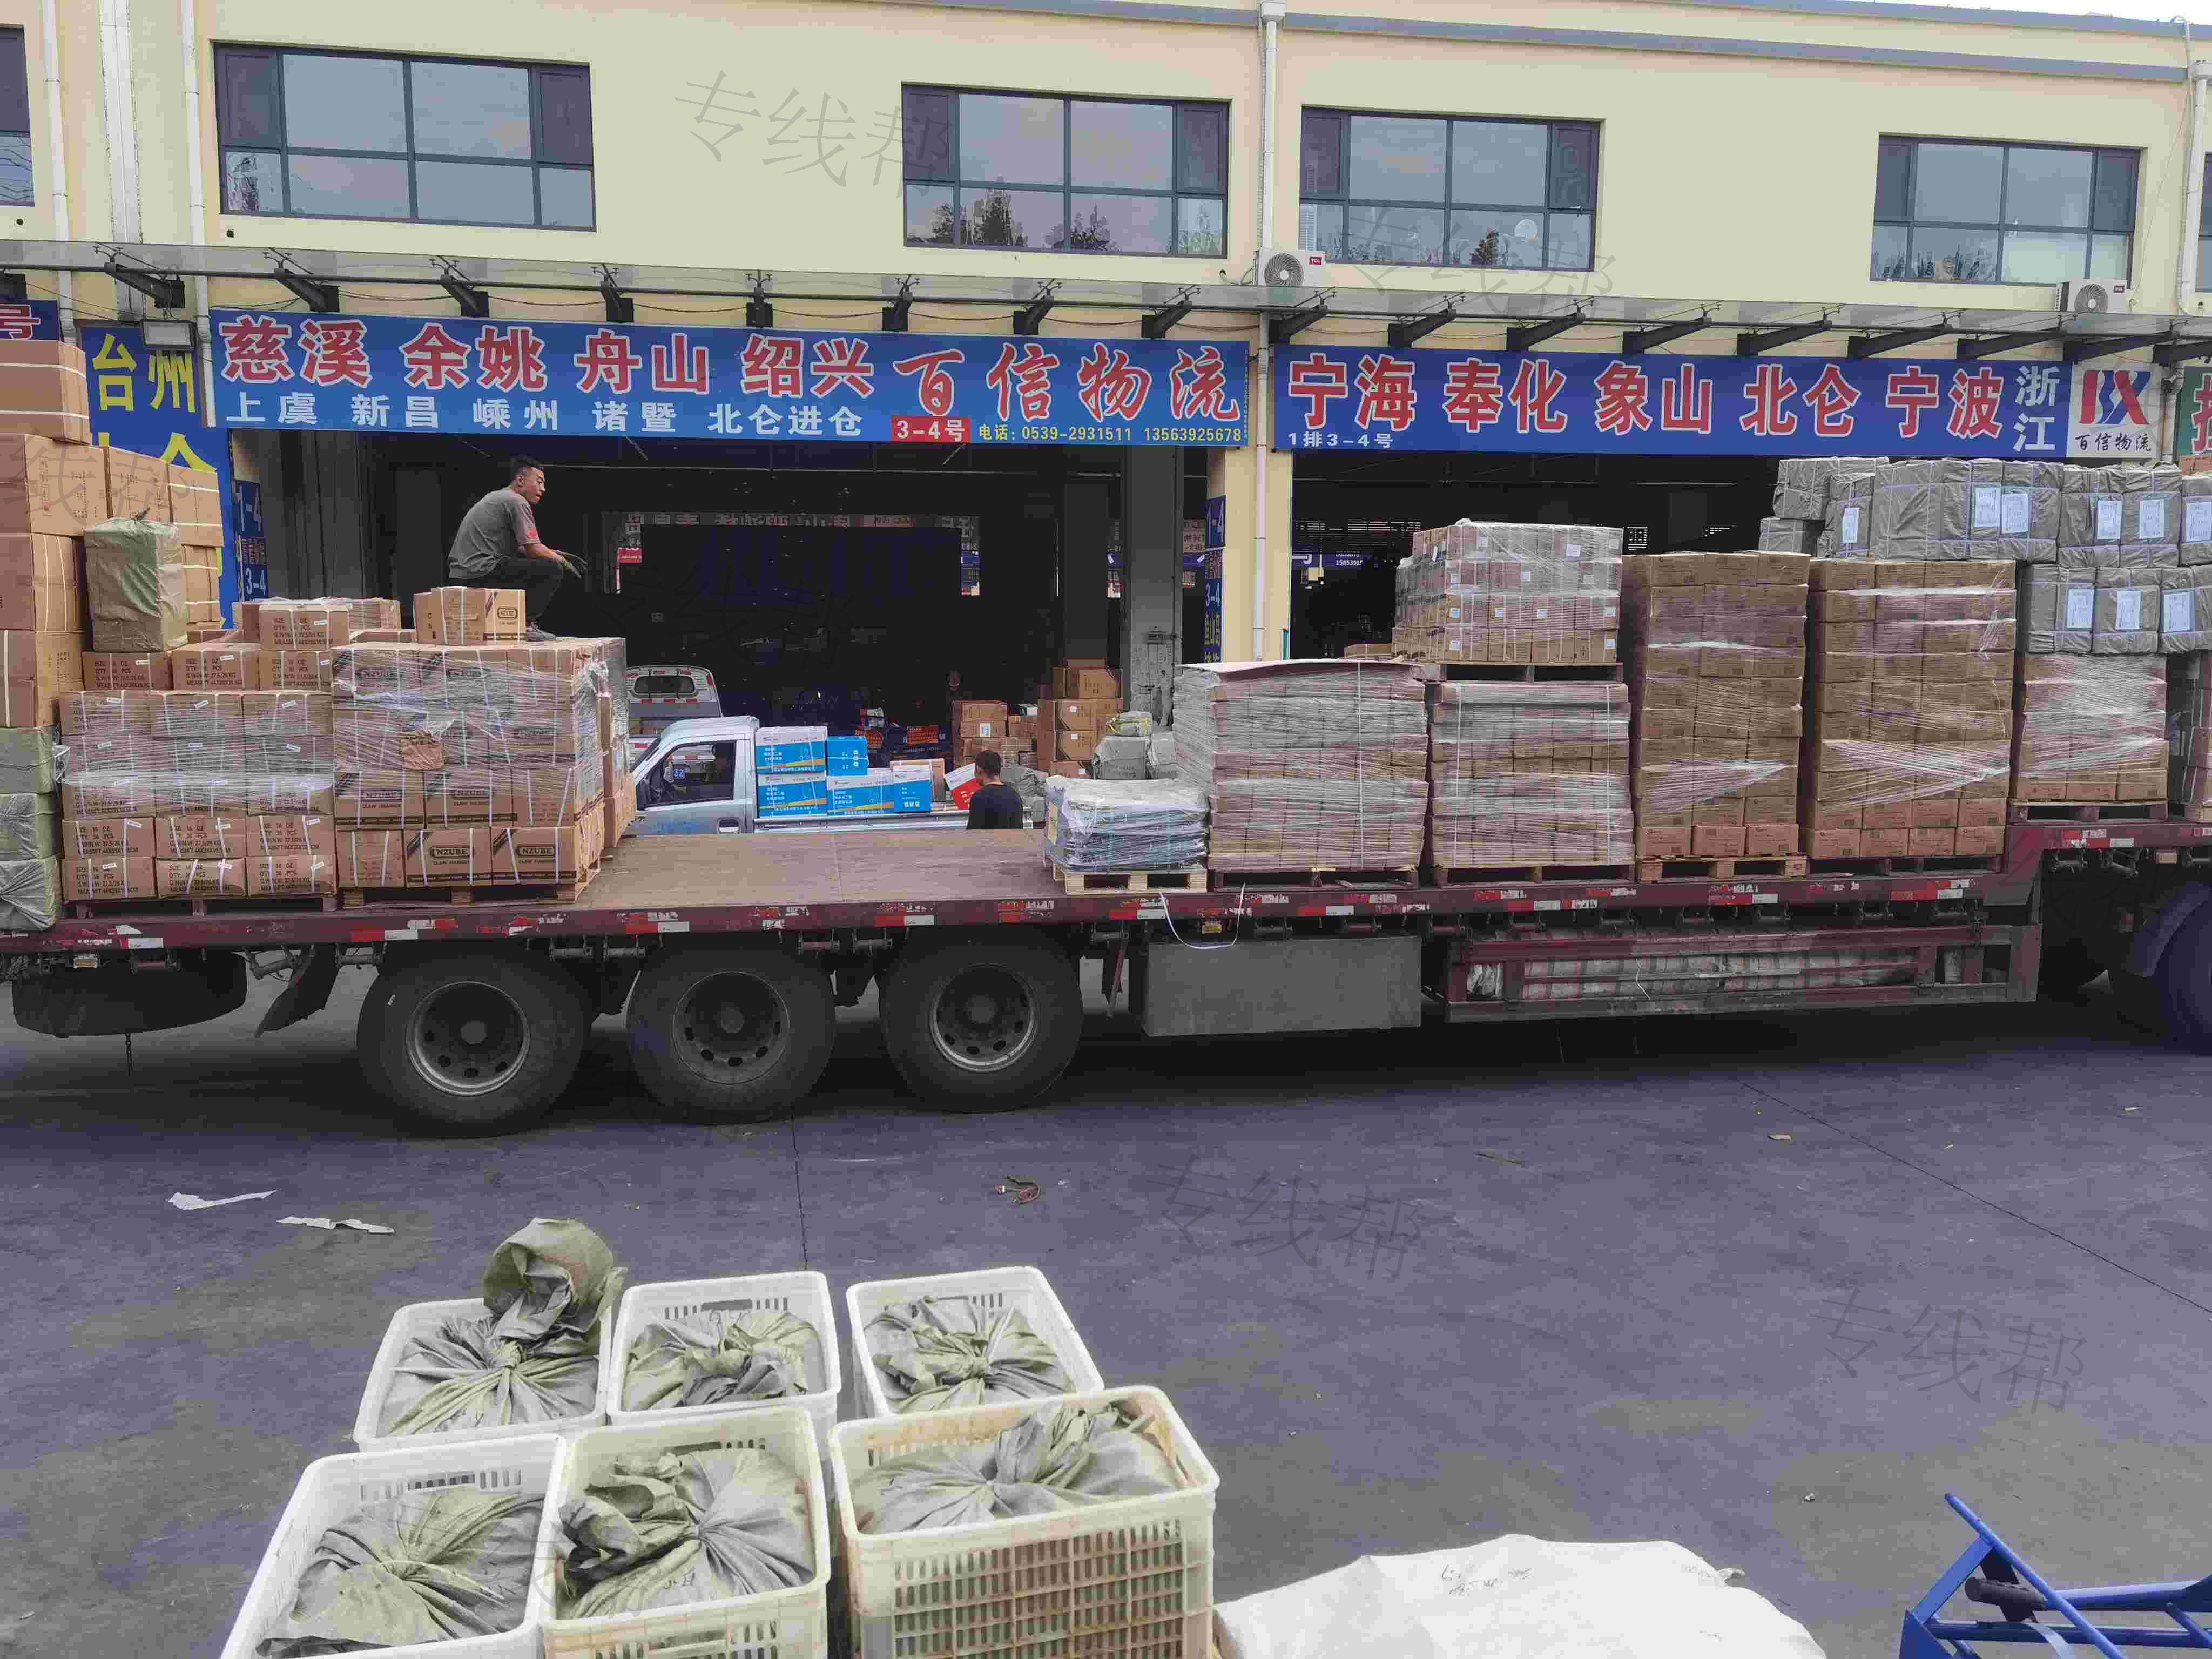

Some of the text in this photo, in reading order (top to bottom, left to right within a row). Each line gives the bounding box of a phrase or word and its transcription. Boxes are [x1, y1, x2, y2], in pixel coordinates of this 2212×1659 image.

[92, 334, 196, 413] 台州
[219, 314, 372, 388] 慈溪
[399, 322, 547, 393] 余姚
[574, 328, 709, 395] 舟山
[741, 333, 874, 398] 绍兴
[893, 342, 1240, 422] 百信物流
[1288, 353, 1416, 432] 宁海
[1442, 358, 1567, 433] 奉化
[1594, 361, 1713, 436] 象山
[1739, 364, 1862, 438] 北仑
[1885, 366, 2004, 439] 宁波
[227, 392, 862, 436] 上虞 新昌 嵊州 诸暨 北仑进仓
[896, 420, 965, 441] 3-4号
[2013, 365, 2060, 452] 浙江
[2075, 434, 2152, 452] 百信物流
